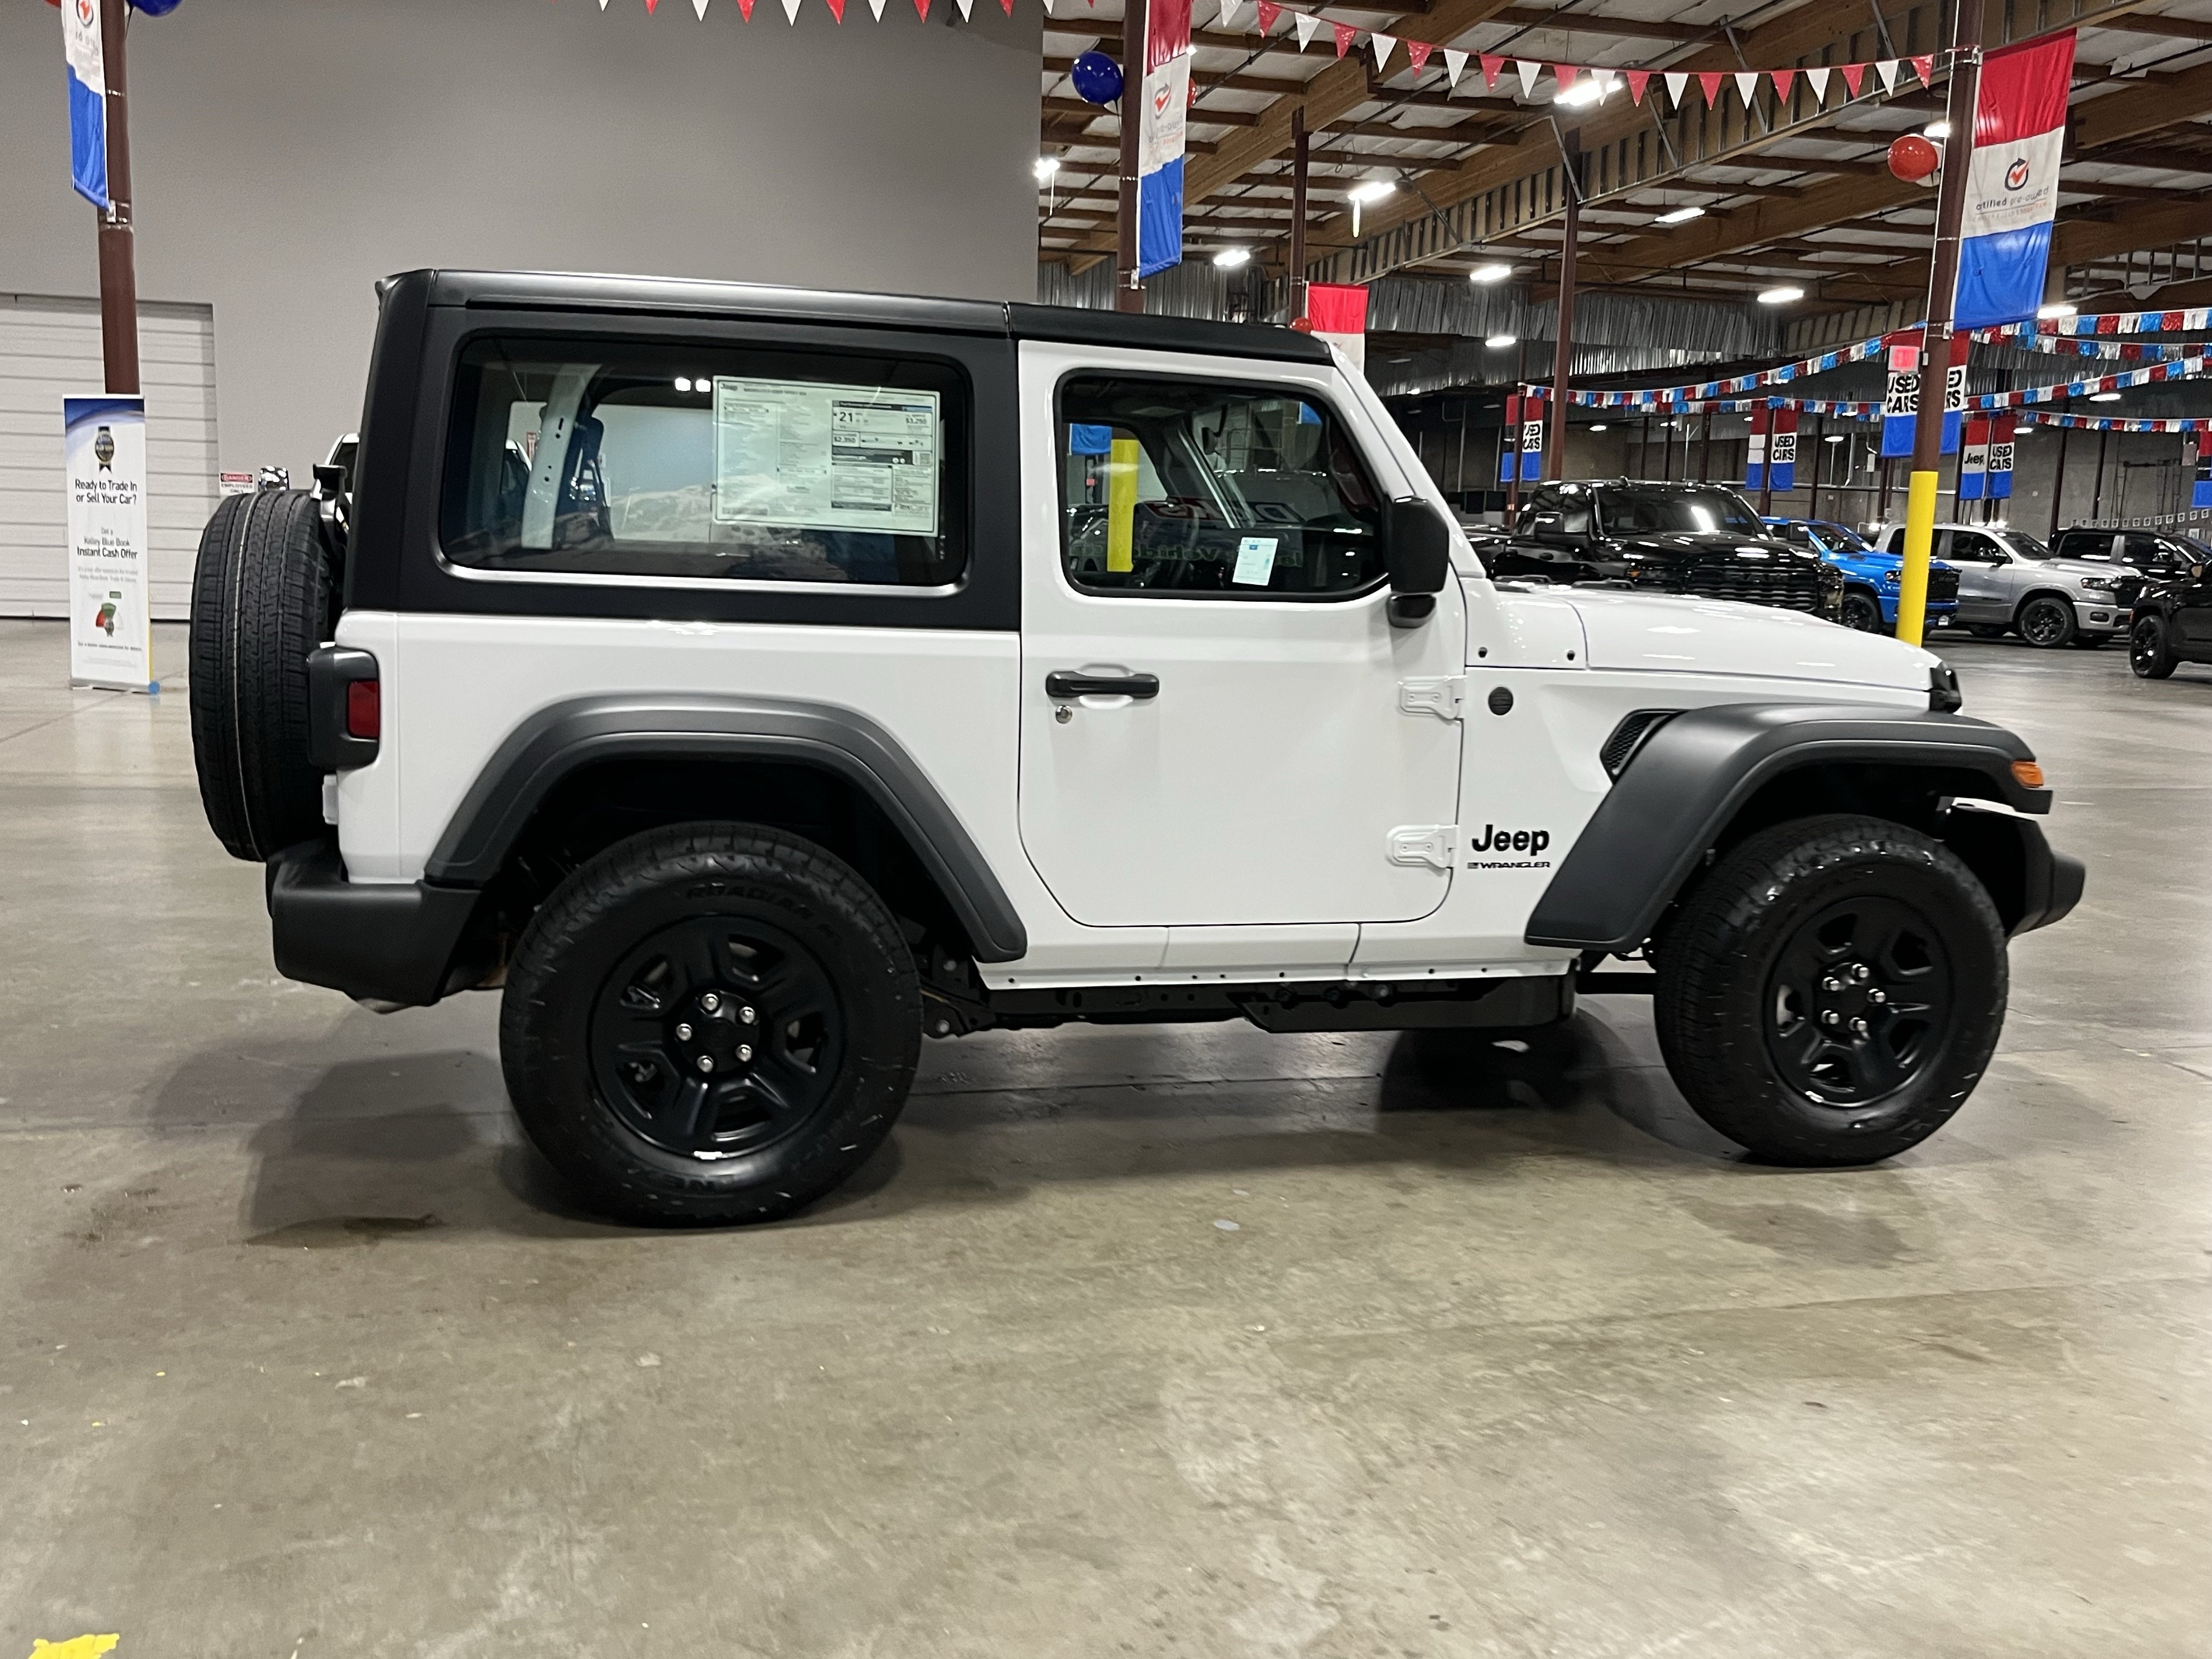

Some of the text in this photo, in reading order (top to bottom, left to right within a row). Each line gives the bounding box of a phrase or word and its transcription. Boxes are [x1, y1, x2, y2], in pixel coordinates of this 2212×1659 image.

[1948, 370, 1962, 388] ED
[839, 412, 853, 422] 21
[1775, 436, 1795, 447] USED
[1993, 445, 2012, 458] USED
[75, 478, 137, 493] Ready to Trade In
[87, 492, 100, 503] Sell
[101, 493, 117, 504] Your
[120, 494, 137, 505] Car?
[77, 546, 138, 560] Instant Cash Offer
[1472, 824, 1550, 856] Jeep
